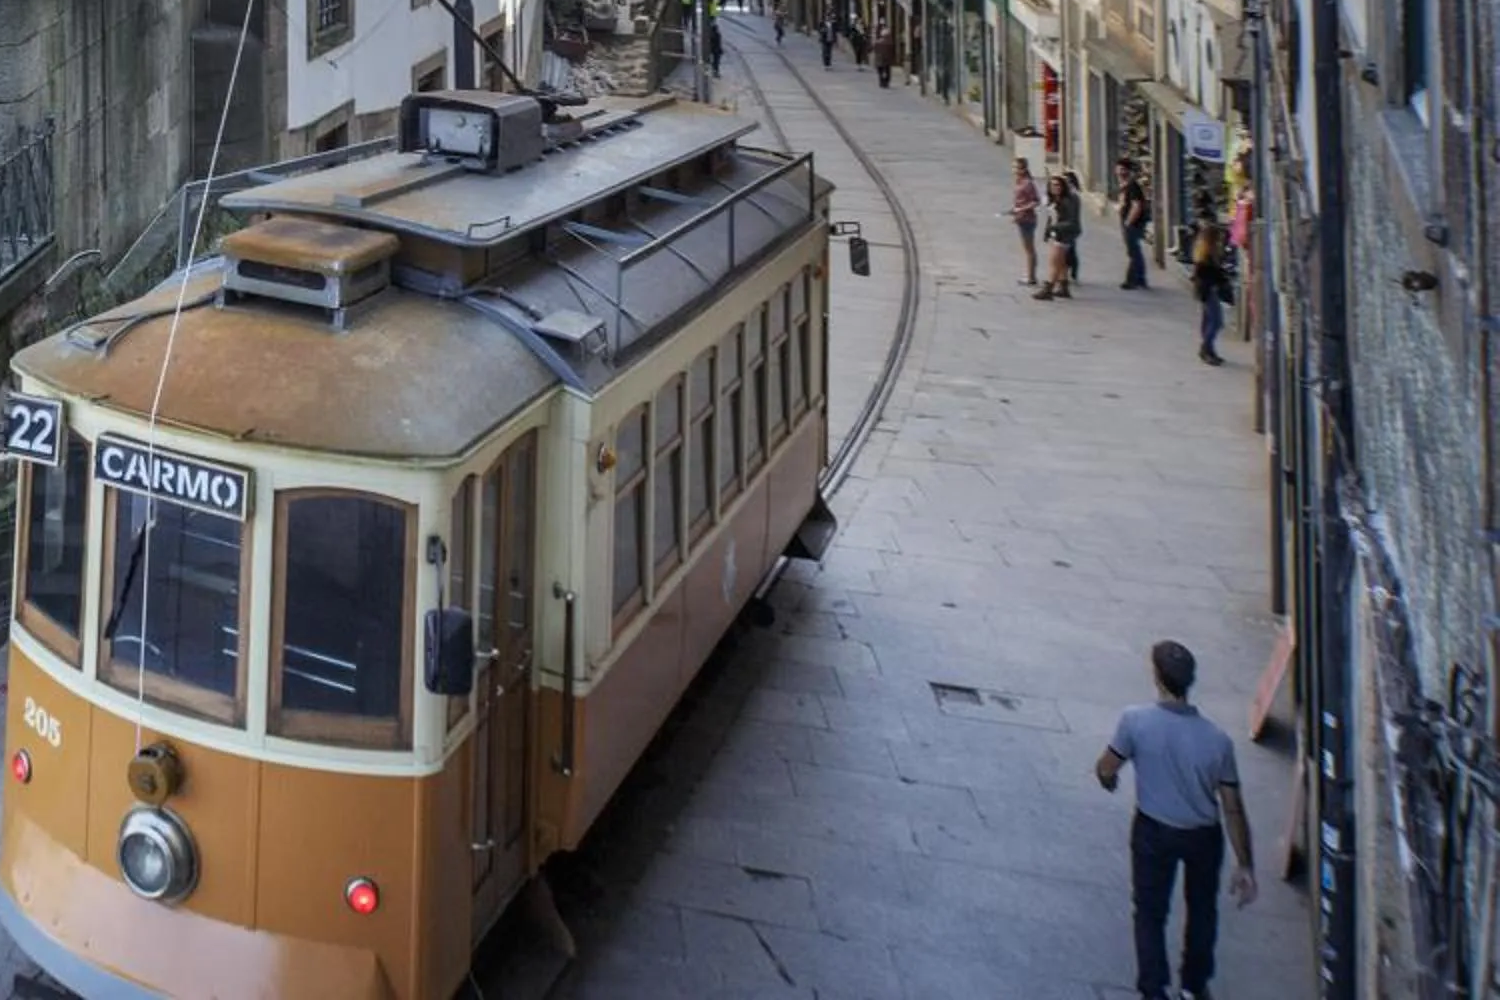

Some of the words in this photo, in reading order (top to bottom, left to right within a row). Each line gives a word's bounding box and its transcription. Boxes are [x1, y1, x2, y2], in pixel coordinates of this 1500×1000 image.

[8, 404, 52, 454] 22
[102, 447, 238, 508] CARMO
[24, 696, 61, 747] 205
